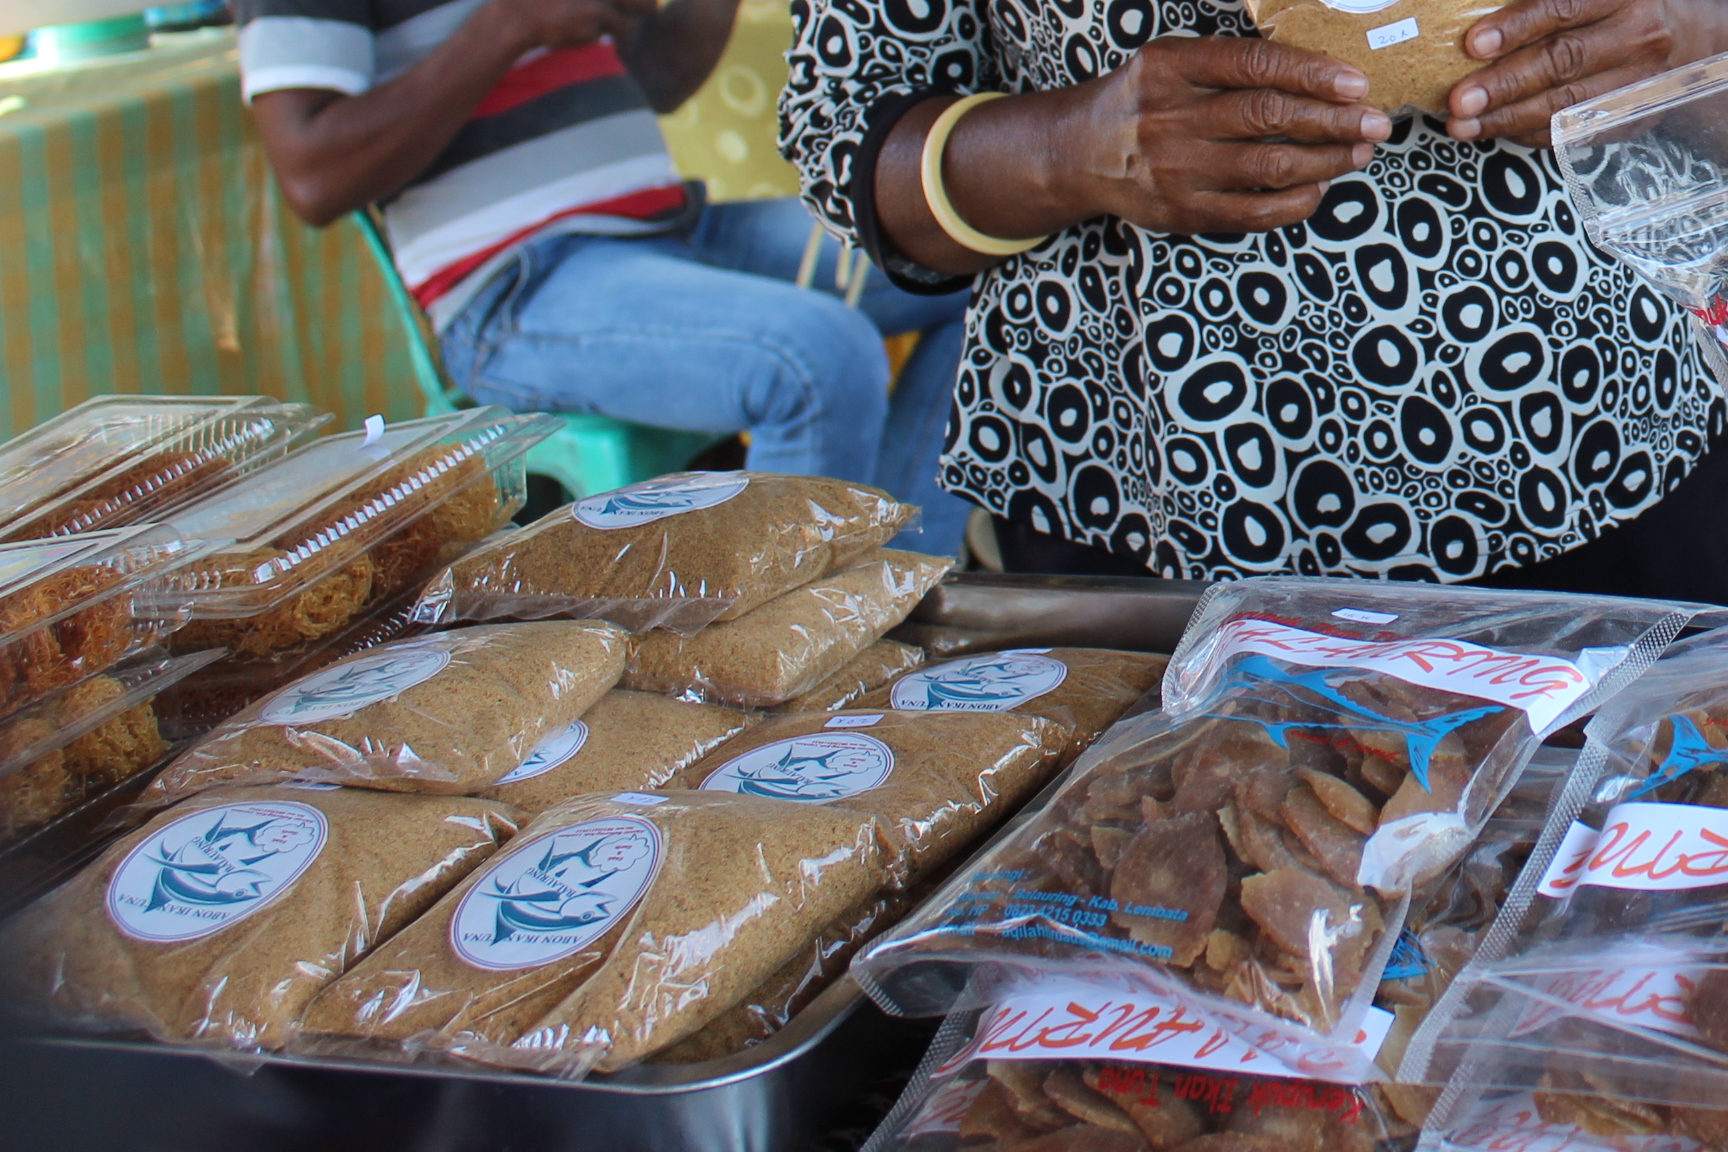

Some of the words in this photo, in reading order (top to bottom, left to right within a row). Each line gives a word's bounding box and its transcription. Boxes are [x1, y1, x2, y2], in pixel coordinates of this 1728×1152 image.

[191, 835, 236, 872] BALAURING
[526, 867, 577, 897] BALAURING
[195, 908, 231, 920] ABON
[970, 904, 990, 915] HP
[1004, 904, 1035, 918] 0823
[1072, 911, 1107, 927] 0333
[1013, 889, 1078, 906] Balauring
[1088, 896, 1119, 911] Kab.
[1123, 901, 1188, 921] Lembata
[544, 935, 582, 945] ABON
[1099, 1067, 1160, 1107] Tuna
[1174, 1072, 1243, 1113] Ikan
[1247, 1079, 1362, 1125] Kerupuk
